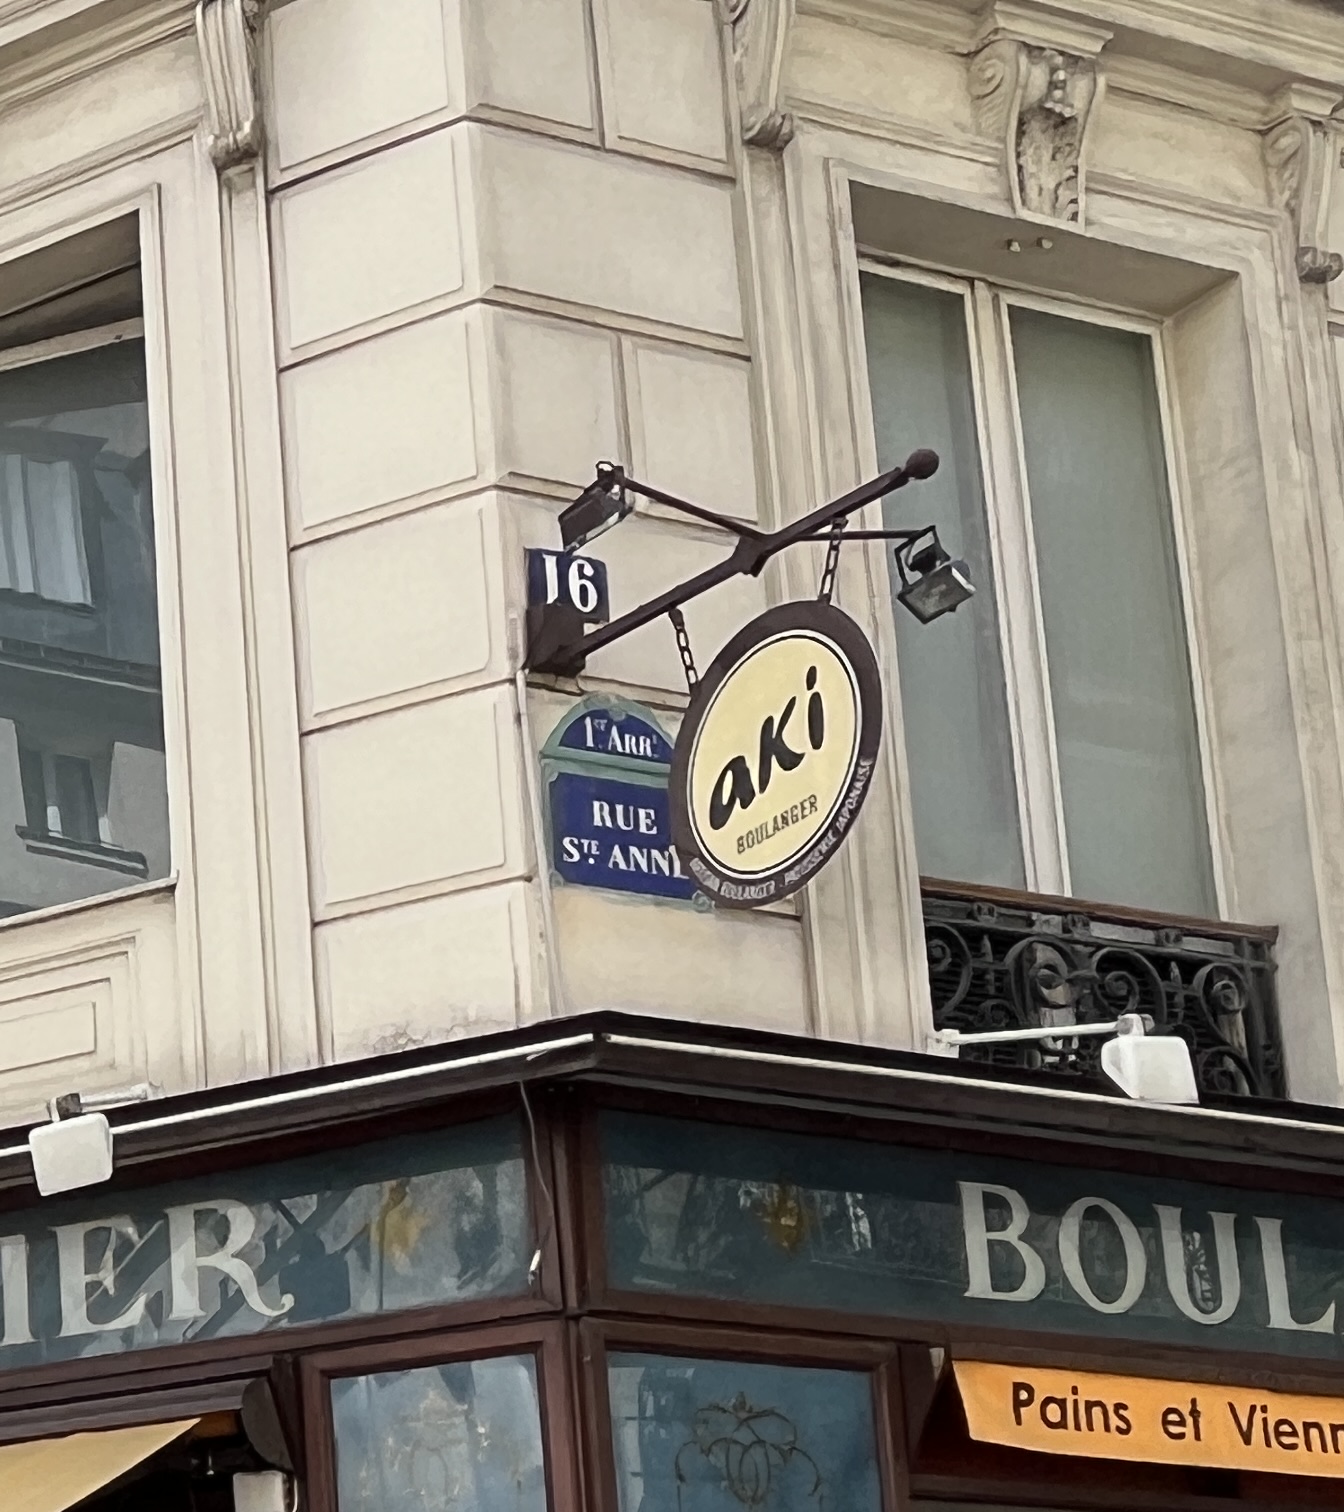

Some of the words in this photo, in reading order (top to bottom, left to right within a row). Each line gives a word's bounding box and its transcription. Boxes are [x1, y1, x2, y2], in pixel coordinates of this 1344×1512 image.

[543, 554, 599, 613] 16
[709, 665, 827, 830] aki
[592, 800, 658, 835] RUE
[737, 794, 819, 854] BOULANGER
[955, 1180, 1336, 1334] BOUL
[1012, 1382, 1132, 1436] Pains
[1161, 1397, 1203, 1442] et
